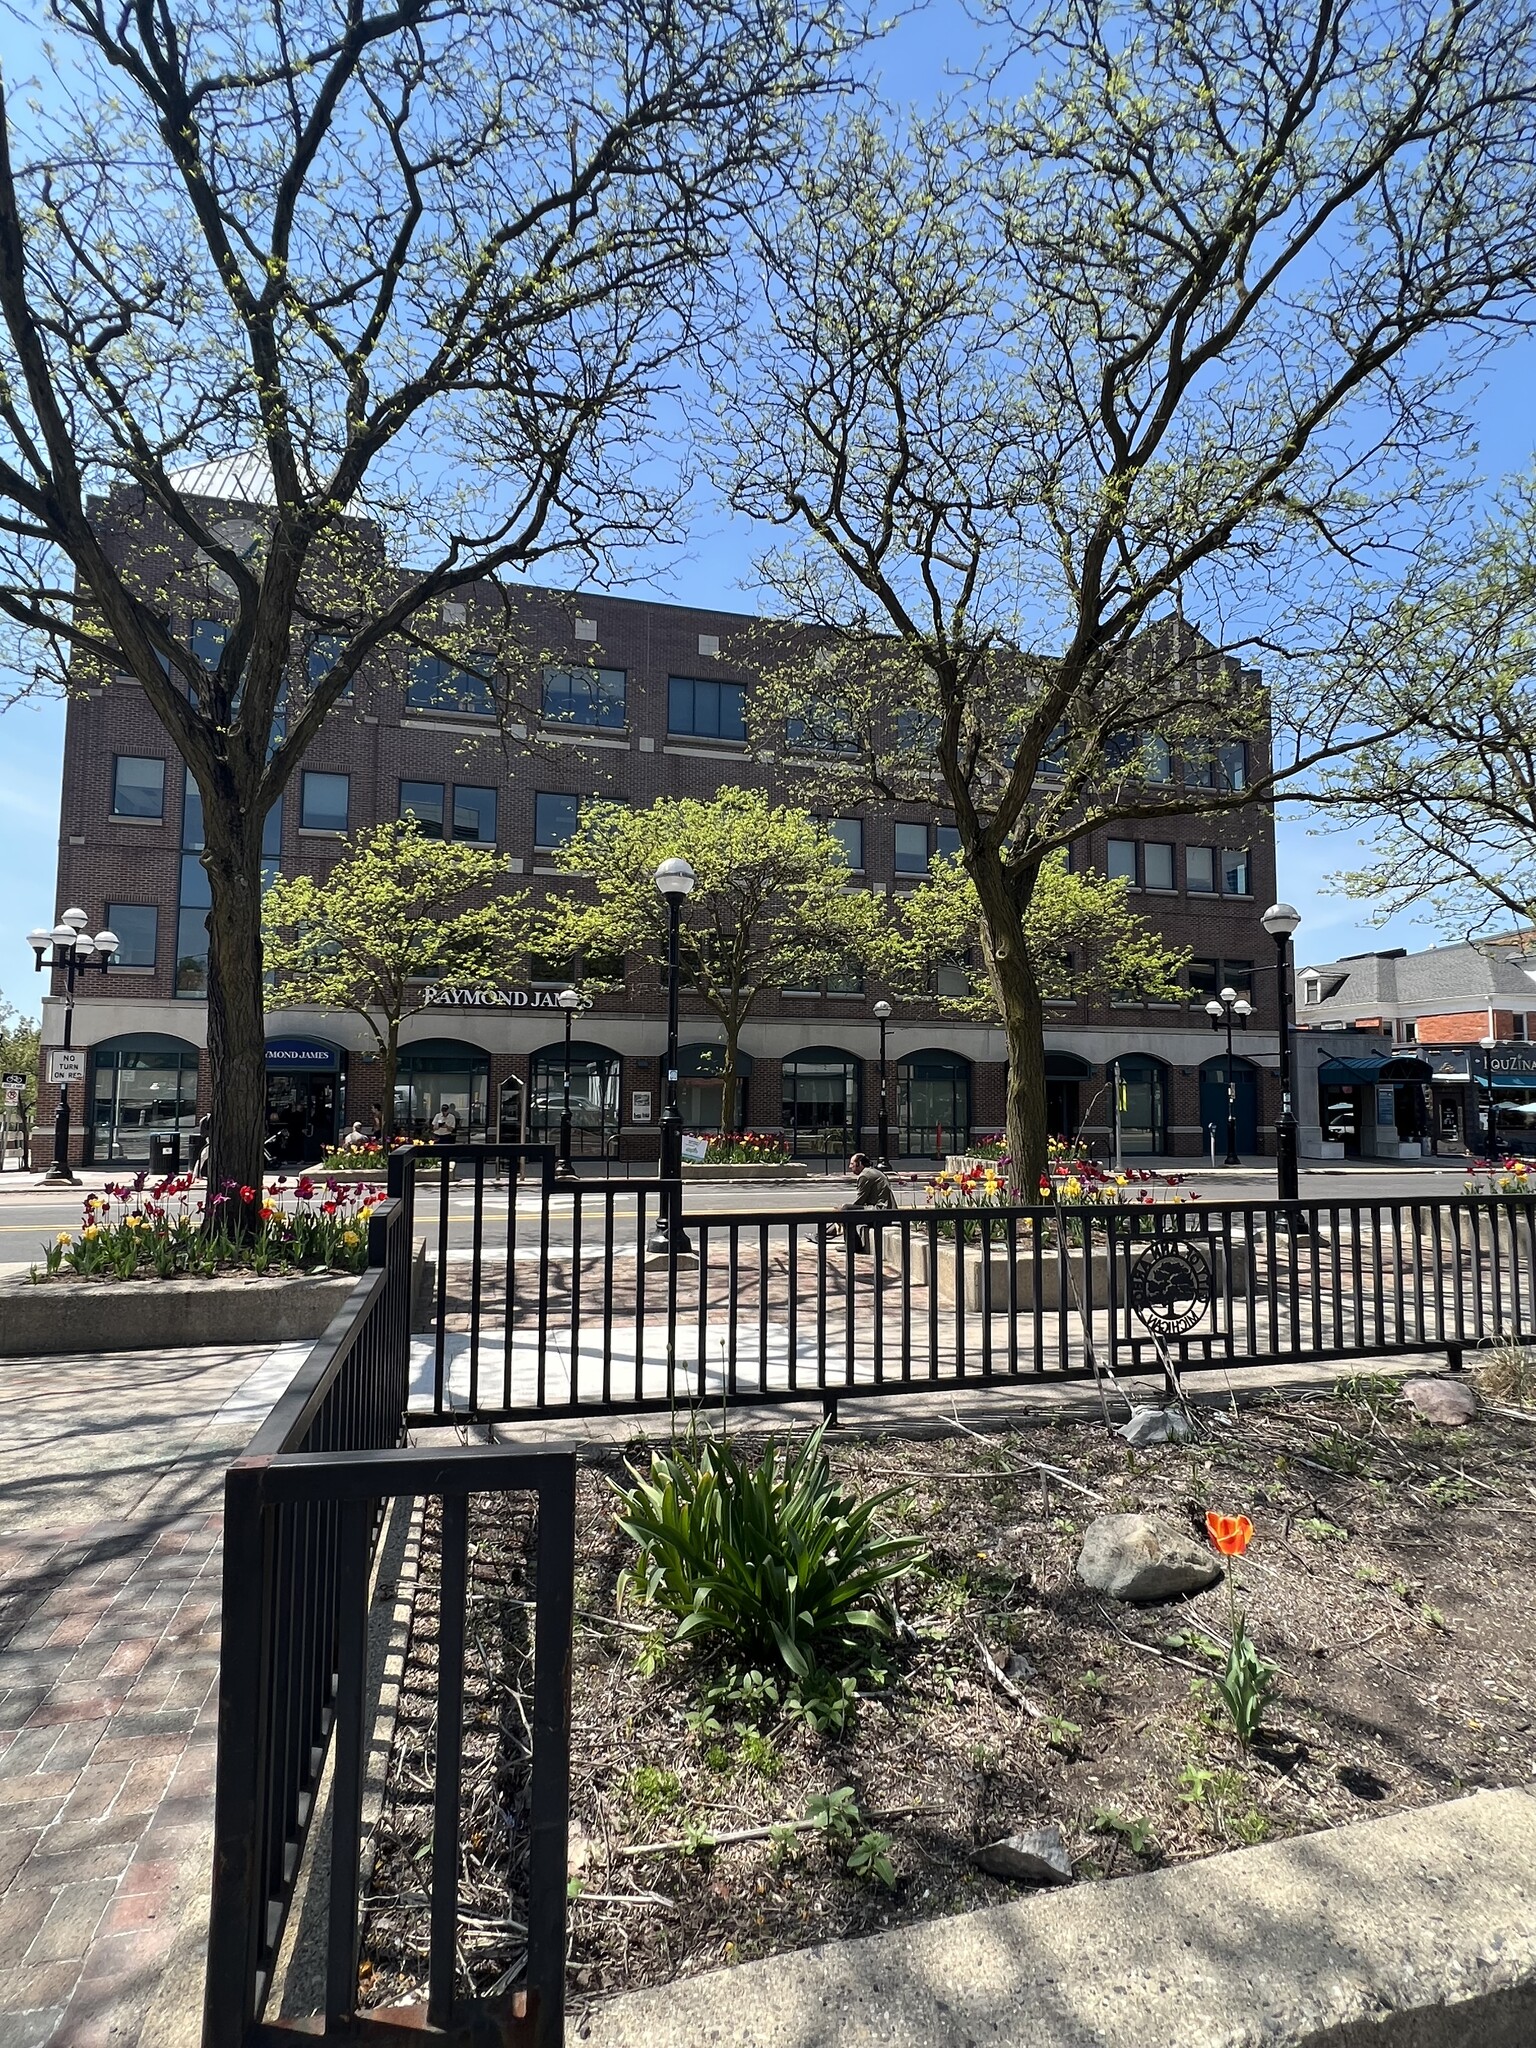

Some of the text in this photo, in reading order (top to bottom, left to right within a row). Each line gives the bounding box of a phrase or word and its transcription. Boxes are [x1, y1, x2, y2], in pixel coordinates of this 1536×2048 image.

[424, 986, 594, 1009] RAYMOND JAS
[265, 1050, 329, 1059] YMOND JAMES
